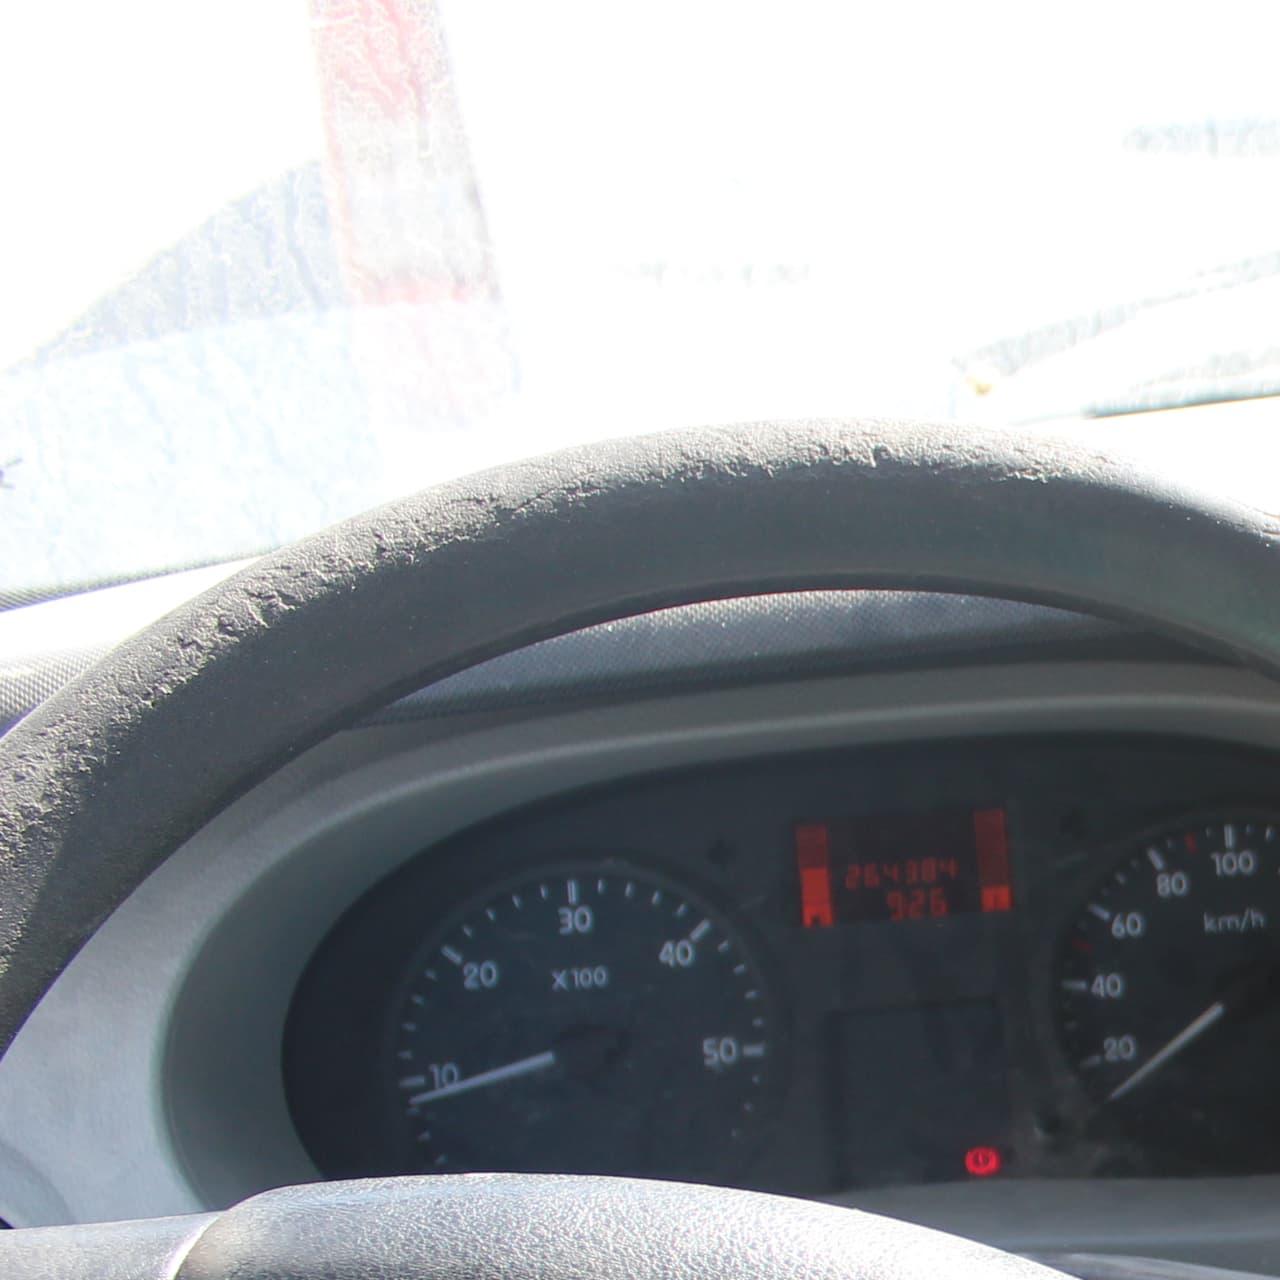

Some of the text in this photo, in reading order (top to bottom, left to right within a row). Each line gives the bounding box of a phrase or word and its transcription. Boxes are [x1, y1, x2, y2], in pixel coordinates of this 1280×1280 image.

[1211, 852, 1256, 875] 100
[1156, 872, 1189, 897] 80
[558, 907, 593, 934] 30
[1111, 913, 1144, 938] 60
[1203, 907, 1266, 933] km/h
[659, 940, 696, 968] 40
[463, 960, 499, 989] 20
[1091, 972, 1124, 998] 40
[703, 1038, 737, 1067] 50
[1103, 1035, 1137, 1061] 20
[428, 1062, 460, 1088] 10
